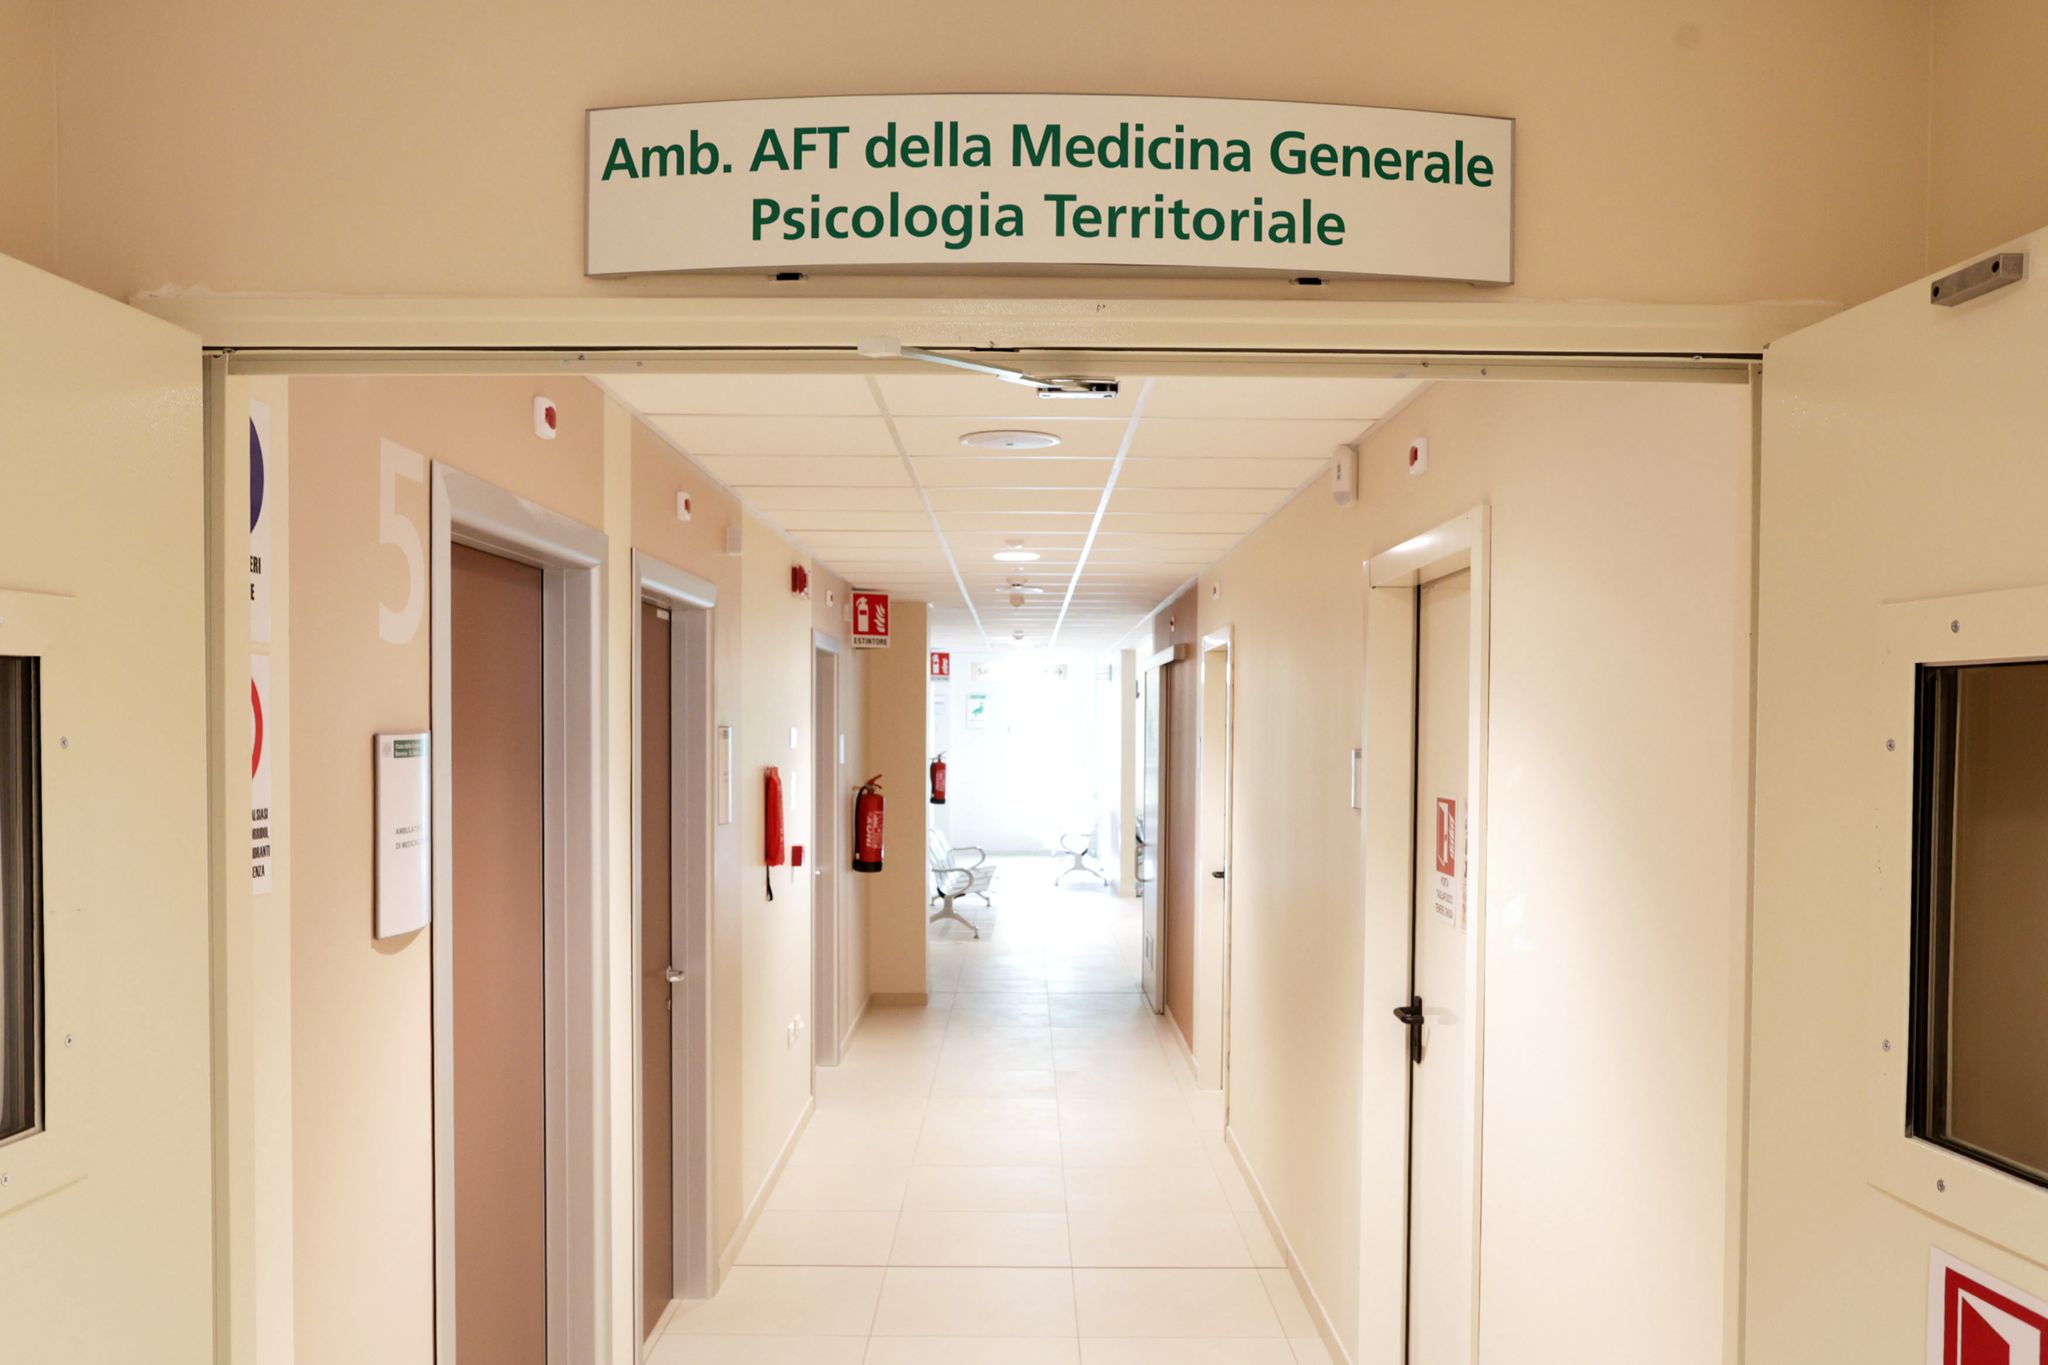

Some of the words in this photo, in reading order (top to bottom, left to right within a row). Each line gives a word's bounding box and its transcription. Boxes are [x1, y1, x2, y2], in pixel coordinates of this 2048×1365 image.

[603, 130, 732, 181] Amb.
[751, 126, 849, 172] AFT
[866, 121, 992, 169] della
[1012, 122, 1252, 173] Medicina
[1270, 130, 1494, 188] Generale
[753, 191, 1025, 250] Psicologia
[1044, 194, 1345, 247] Territoriale
[379, 436, 425, 645] 5
[853, 637, 887, 645] ESTINTORE
